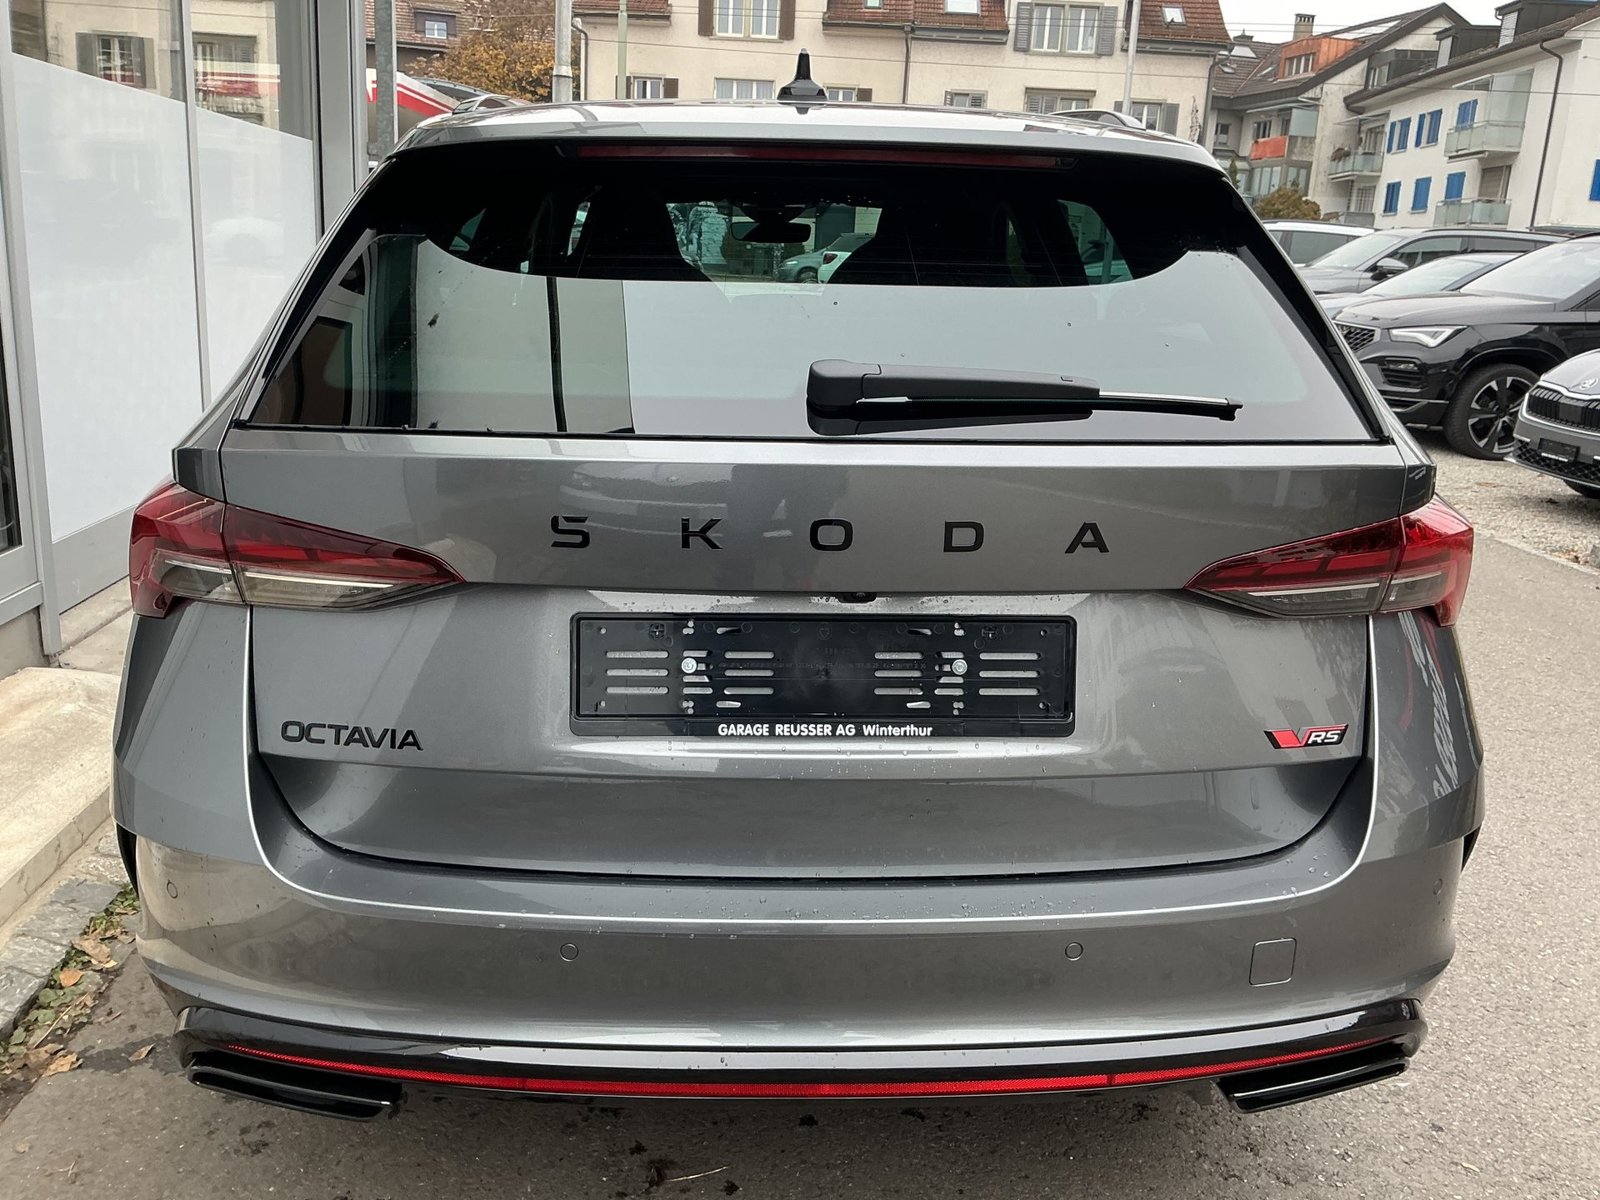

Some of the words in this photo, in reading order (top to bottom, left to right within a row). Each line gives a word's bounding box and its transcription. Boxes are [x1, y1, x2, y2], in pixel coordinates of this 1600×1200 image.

[281, 720, 422, 750] OCTAVIA
[717, 723, 770, 737] GARAGE
[775, 723, 832, 737] REUSSER
[836, 723, 856, 737] AG
[863, 723, 933, 737] Winterthur
